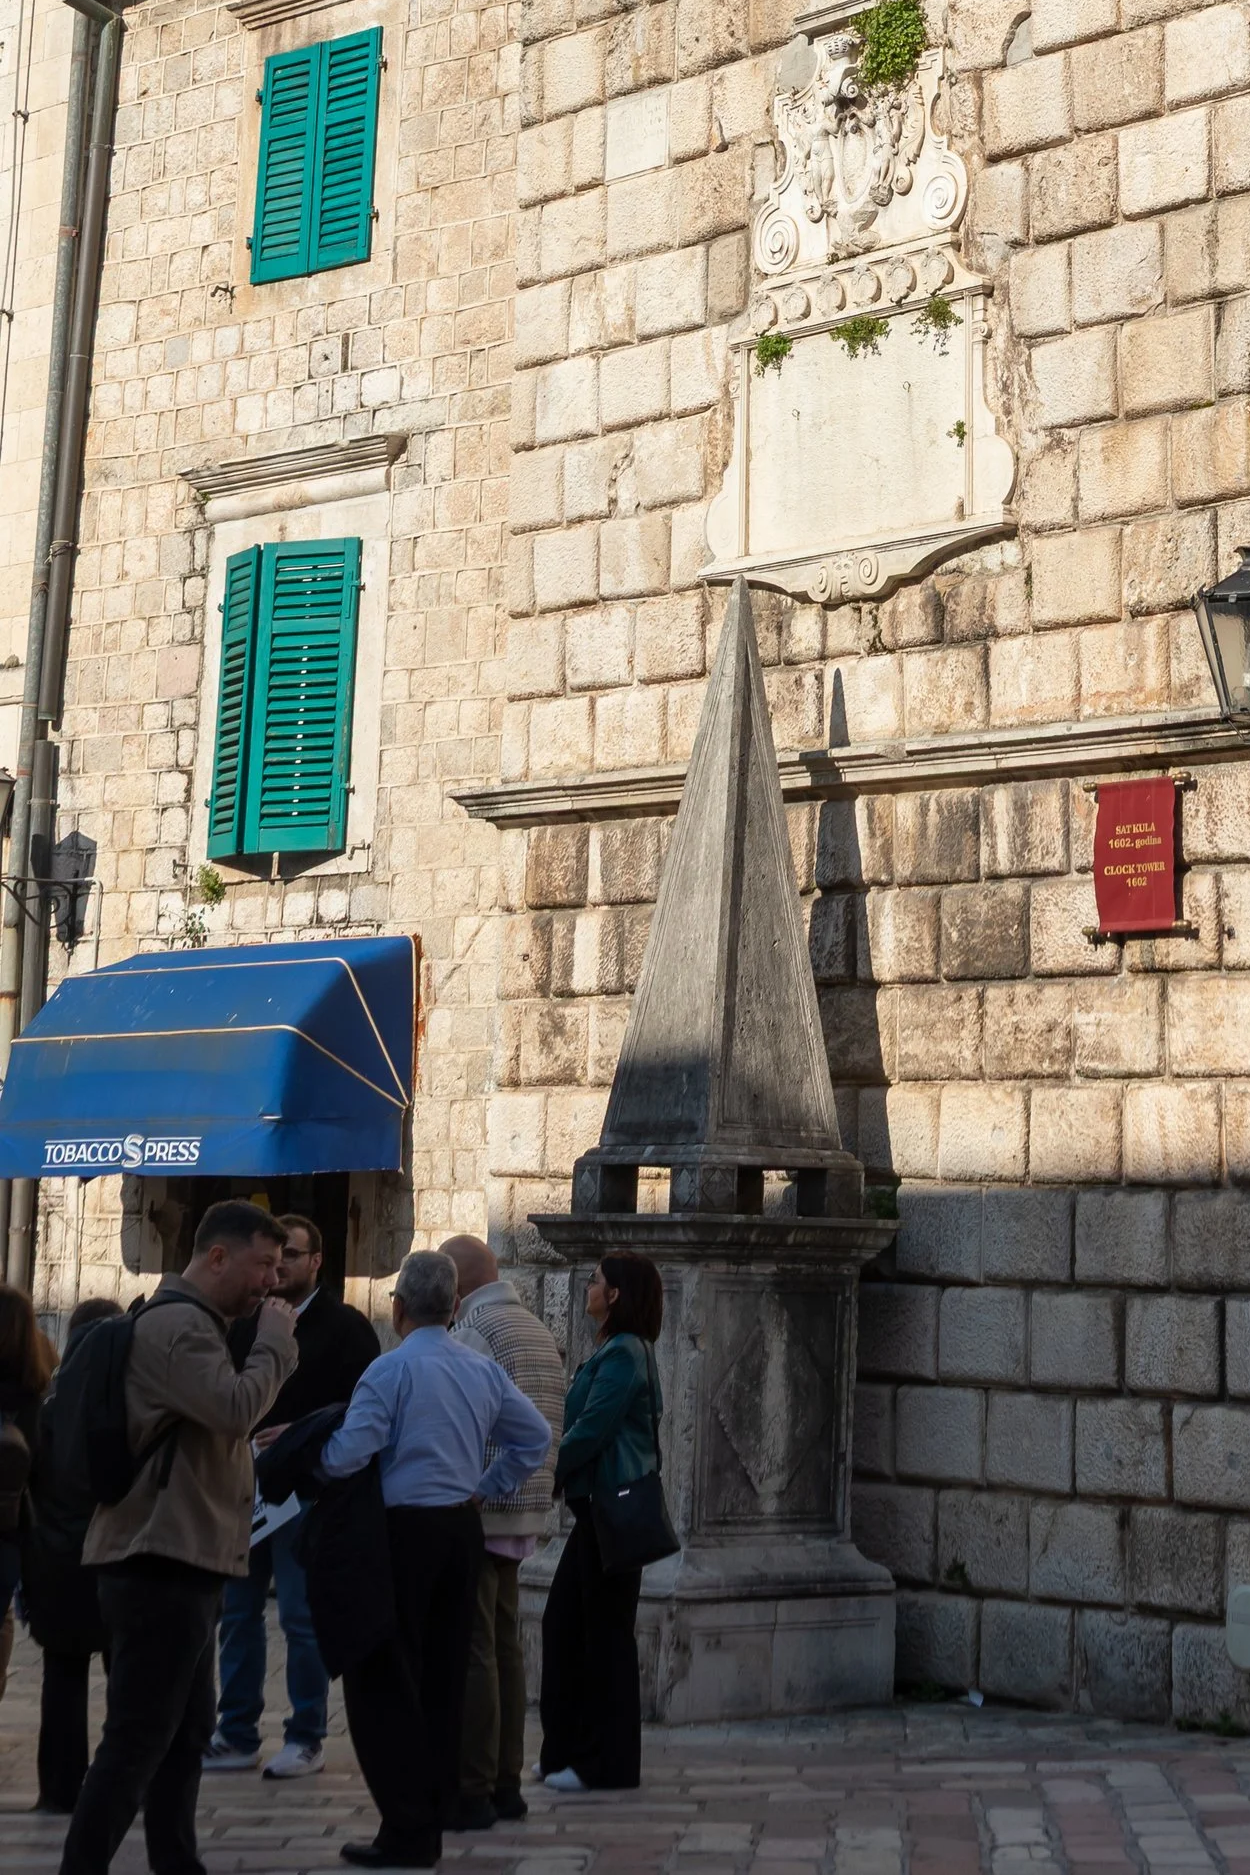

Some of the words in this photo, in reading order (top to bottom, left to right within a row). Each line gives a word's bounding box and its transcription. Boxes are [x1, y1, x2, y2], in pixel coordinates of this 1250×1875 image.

[1115, 824, 1132, 835] SAT
[1132, 821, 1156, 834] KULA
[1108, 837, 1134, 849] 1602.
[1135, 835, 1162, 849] godina
[1103, 863, 1135, 876] CLOCK
[1135, 861, 1166, 873] TOWER
[1126, 876, 1148, 888] 1602
